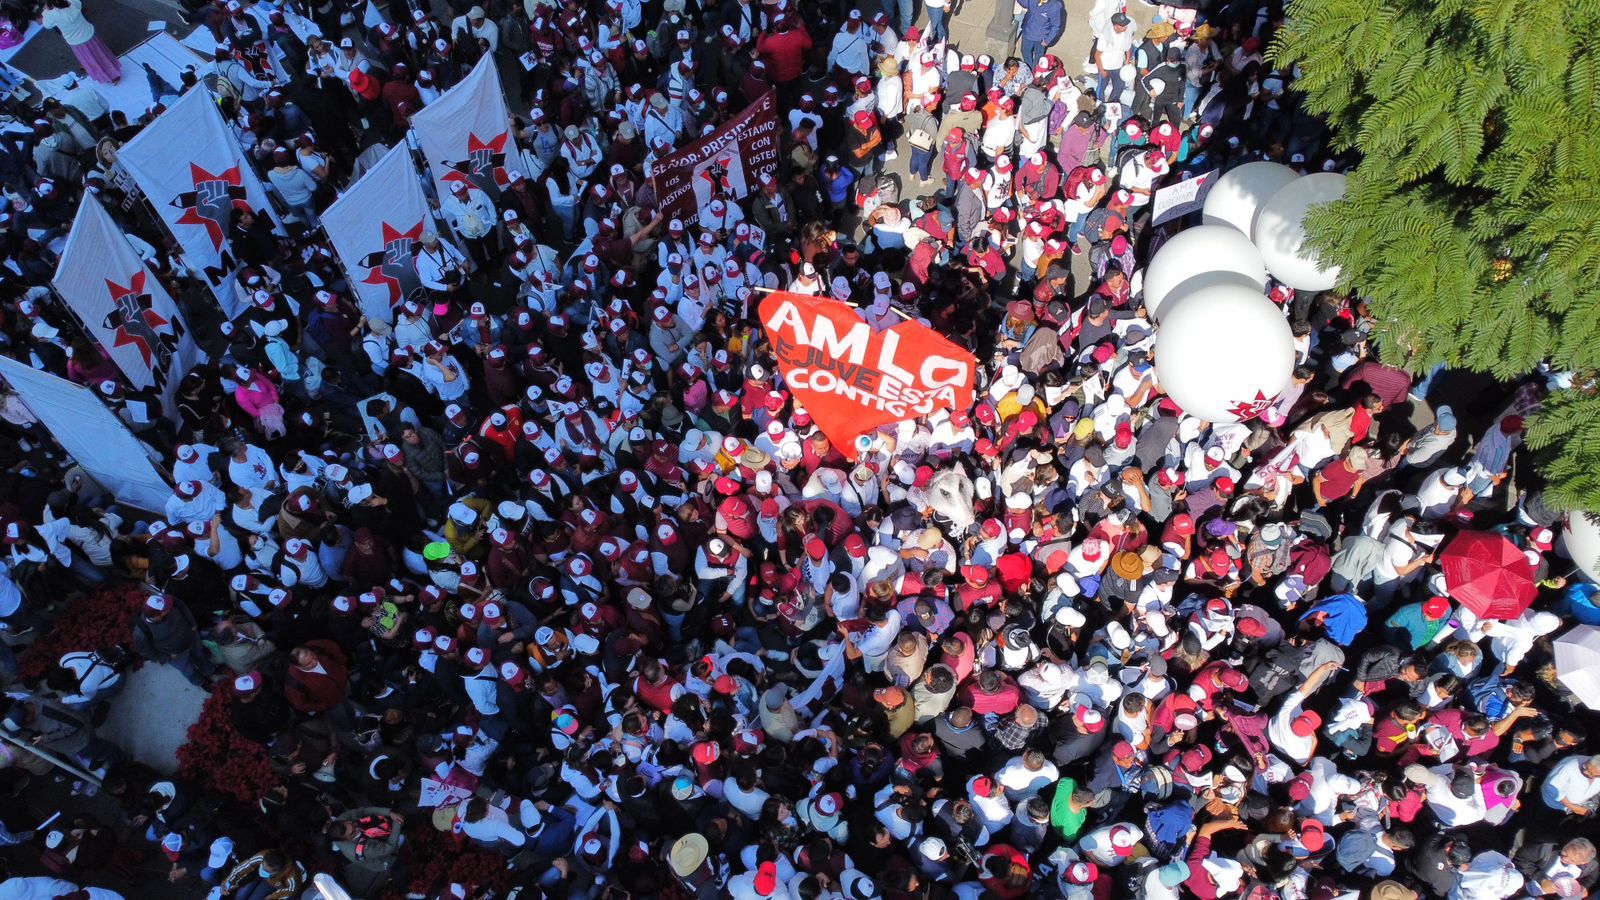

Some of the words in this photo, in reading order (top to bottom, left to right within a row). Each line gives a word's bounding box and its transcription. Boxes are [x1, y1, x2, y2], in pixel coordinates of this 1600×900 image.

[738, 120, 776, 142] ESTAMO
[751, 136, 771, 151] CON
[749, 149, 777, 165] USTED
[665, 175, 680, 187] LOS
[671, 208, 682, 218] DE
[766, 301, 968, 389] AMLO
